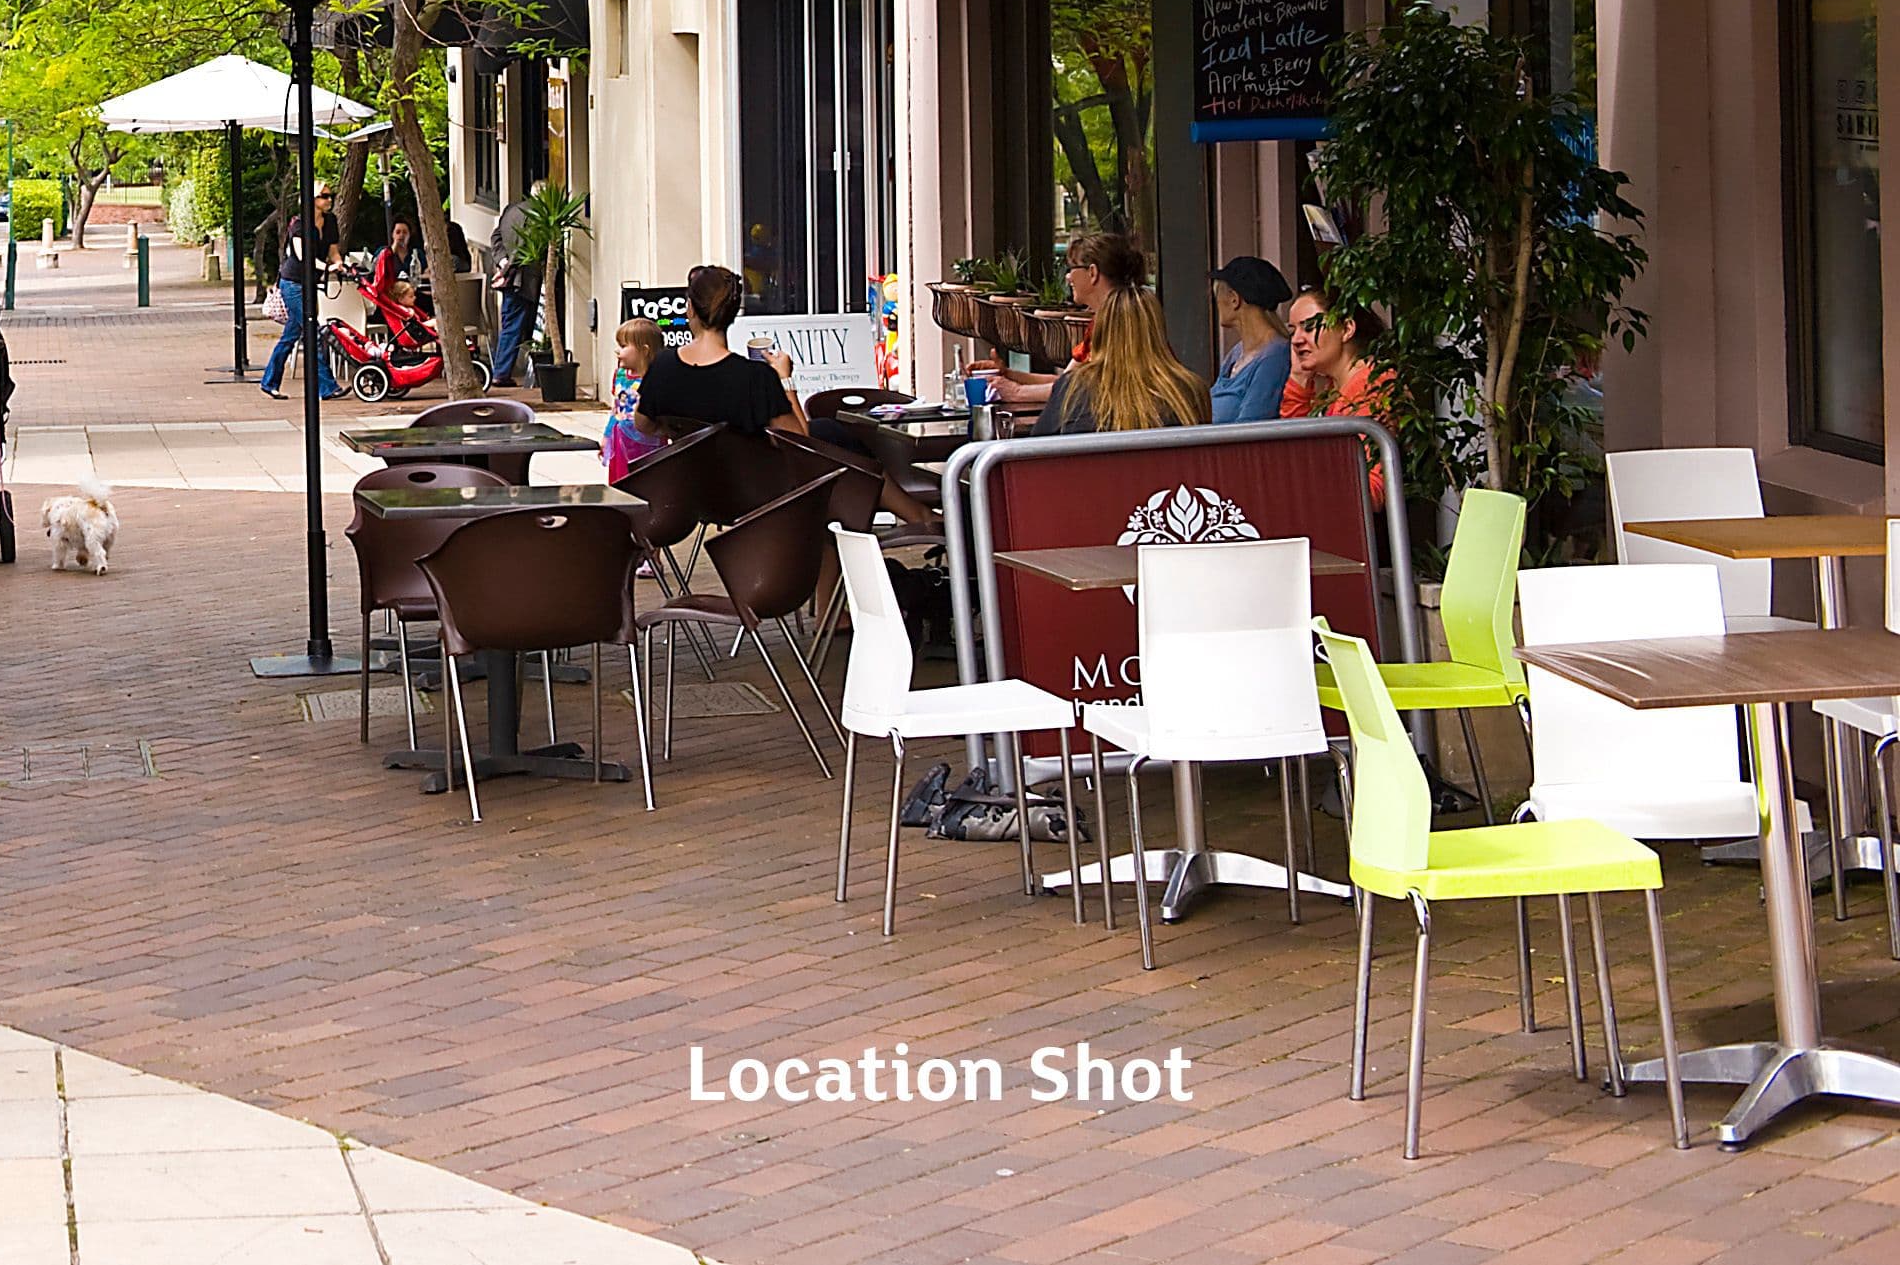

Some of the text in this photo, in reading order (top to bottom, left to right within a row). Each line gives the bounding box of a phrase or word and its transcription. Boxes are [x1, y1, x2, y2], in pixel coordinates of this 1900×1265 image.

[1202, 21, 1330, 72] Iced Latte
[1208, 65, 1256, 95] Apple
[1273, 56, 1312, 75] Berry
[631, 296, 689, 320] rasc
[750, 328, 849, 366] ANITY
